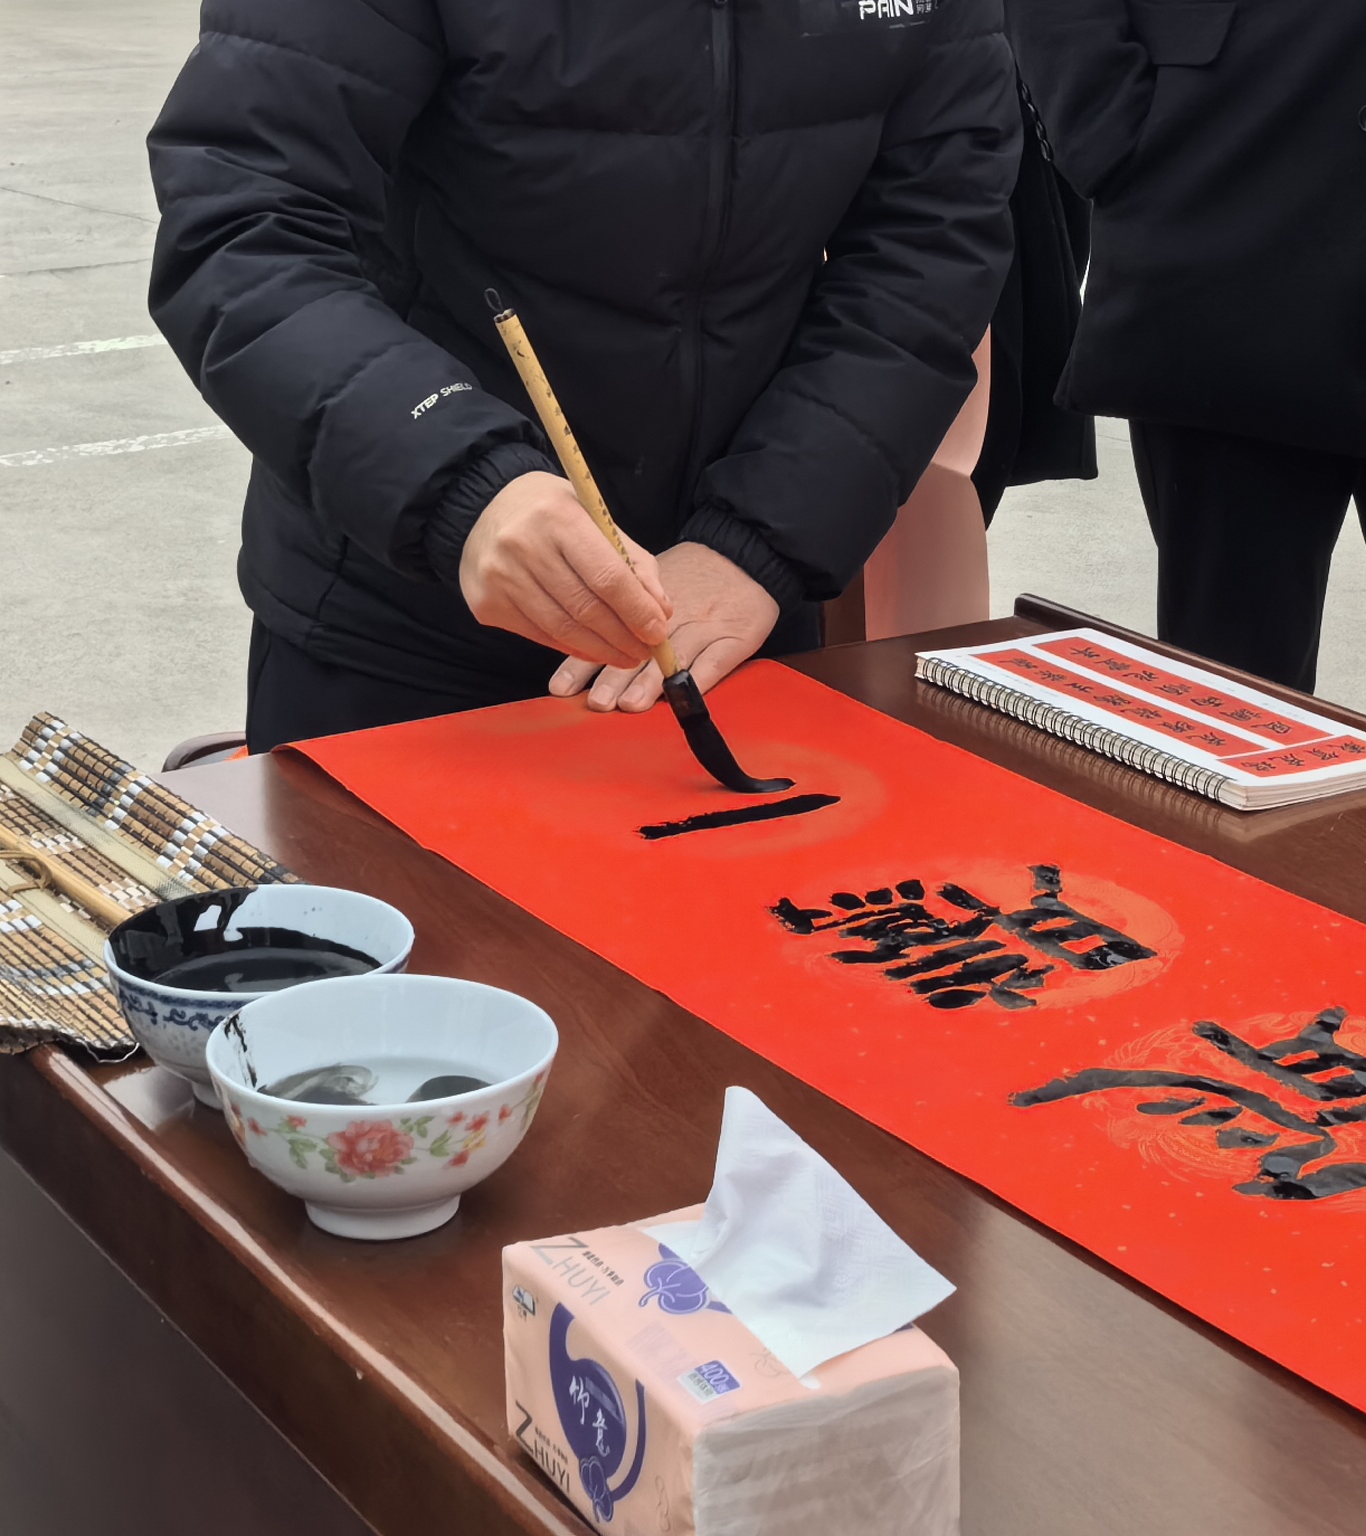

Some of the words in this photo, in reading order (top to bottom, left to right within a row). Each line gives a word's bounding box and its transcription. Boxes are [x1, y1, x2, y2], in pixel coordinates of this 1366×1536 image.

[410, 393, 439, 419] XTEP
[531, 1236, 611, 1305] ZHUYI
[516, 1400, 570, 1494] ZHUYI
